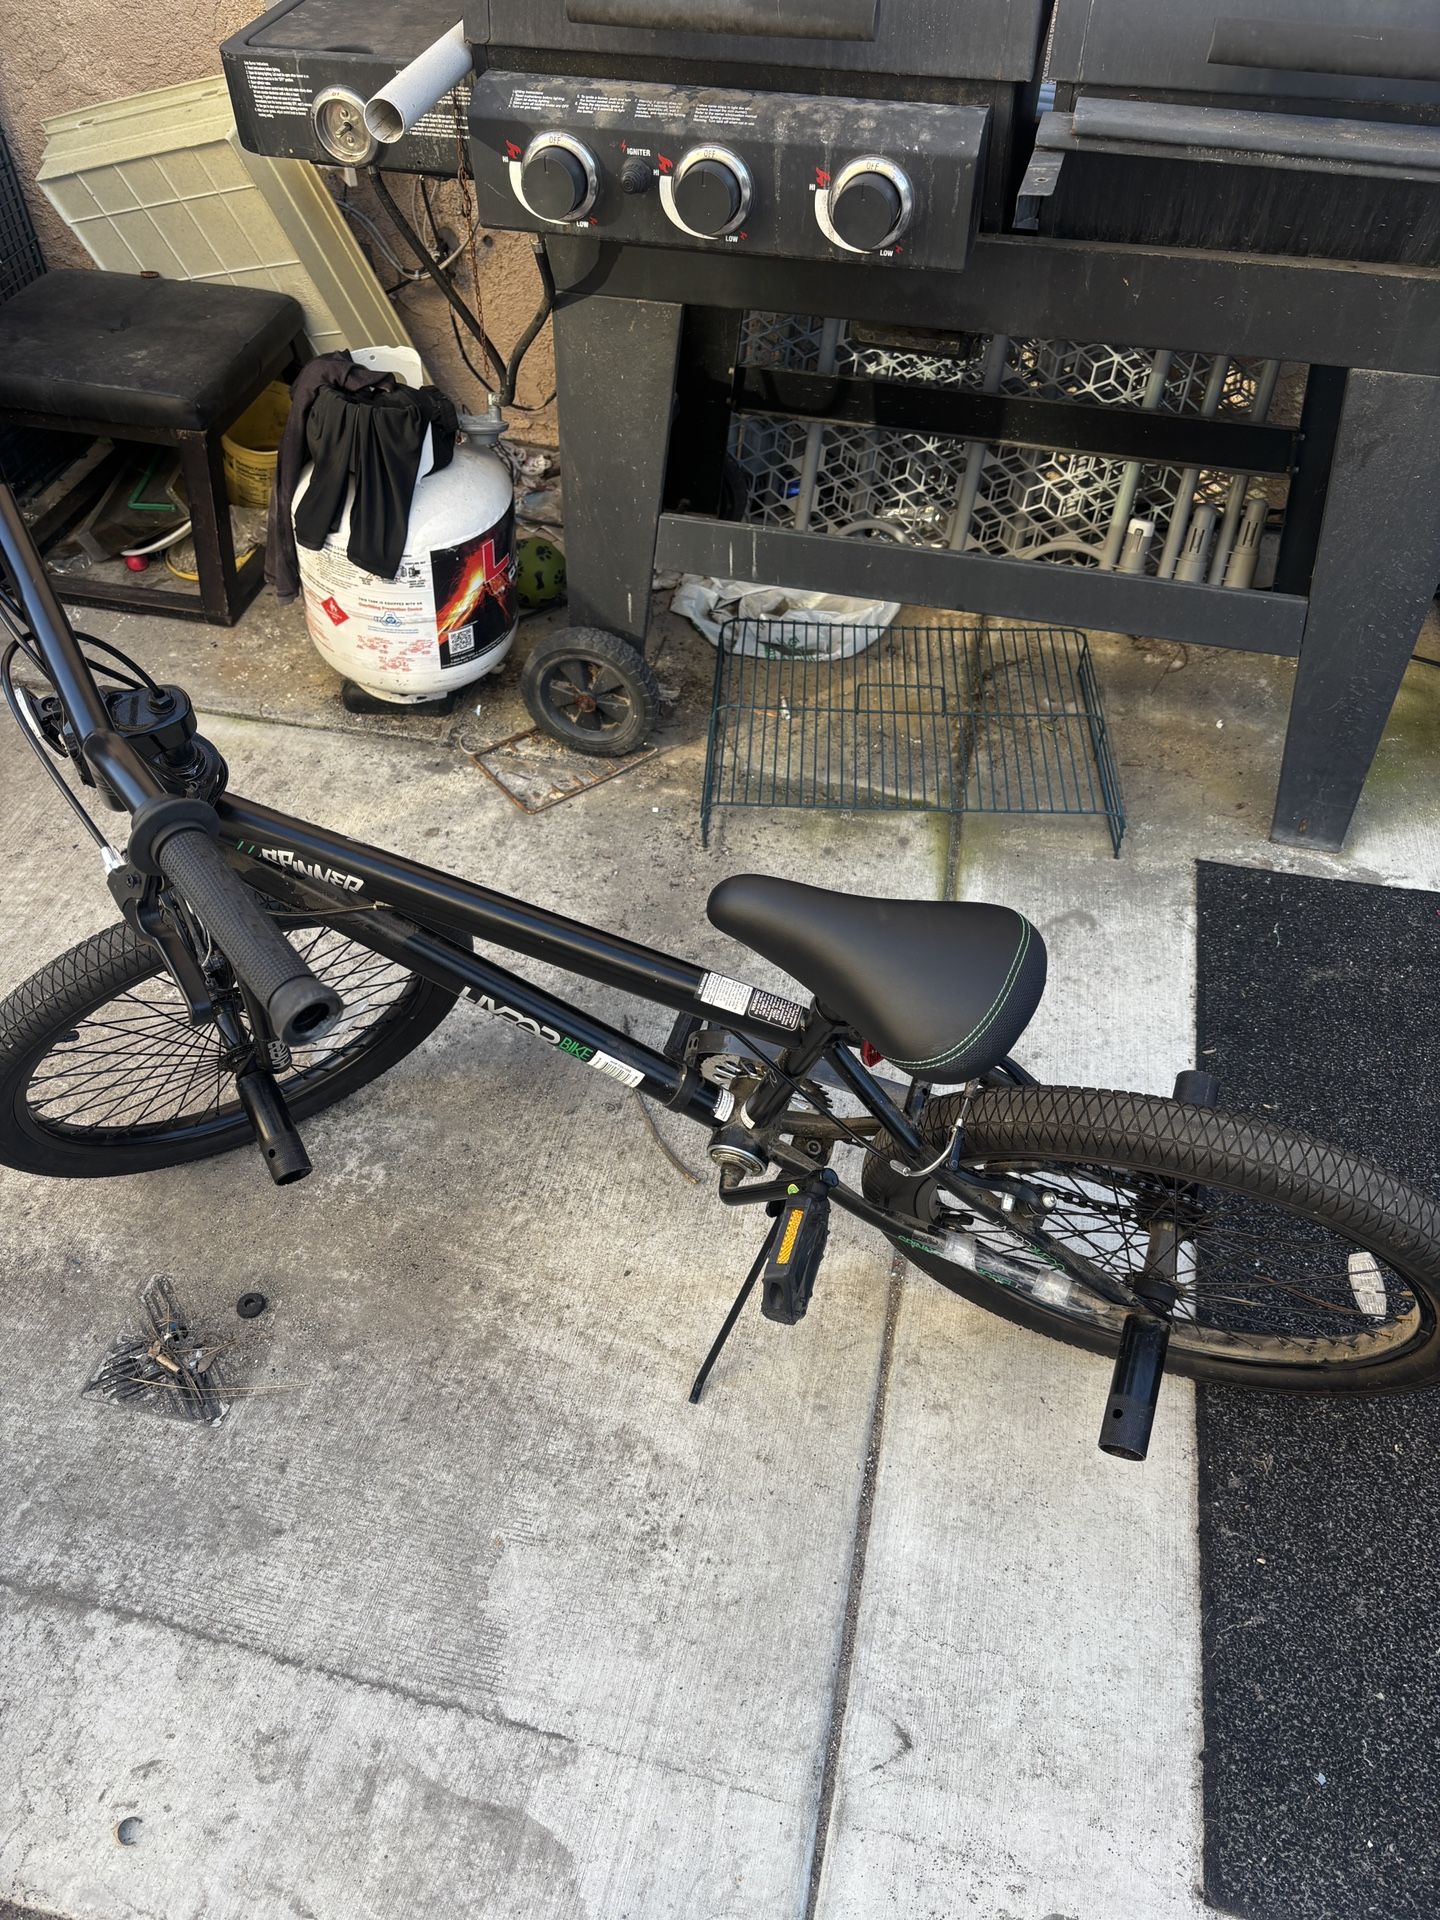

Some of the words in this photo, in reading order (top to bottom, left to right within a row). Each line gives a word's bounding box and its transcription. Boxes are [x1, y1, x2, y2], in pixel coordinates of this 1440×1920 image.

[549, 136, 561, 145] OFF
[626, 147, 651, 157] IGNITER
[703, 150, 716, 159] OFF
[866, 162, 879, 171] OFF
[809, 183, 816, 191] HI
[725, 235, 739, 243] LOW
[880, 249, 894, 257] LOW
[559, 1036, 594, 1061] BIKE
